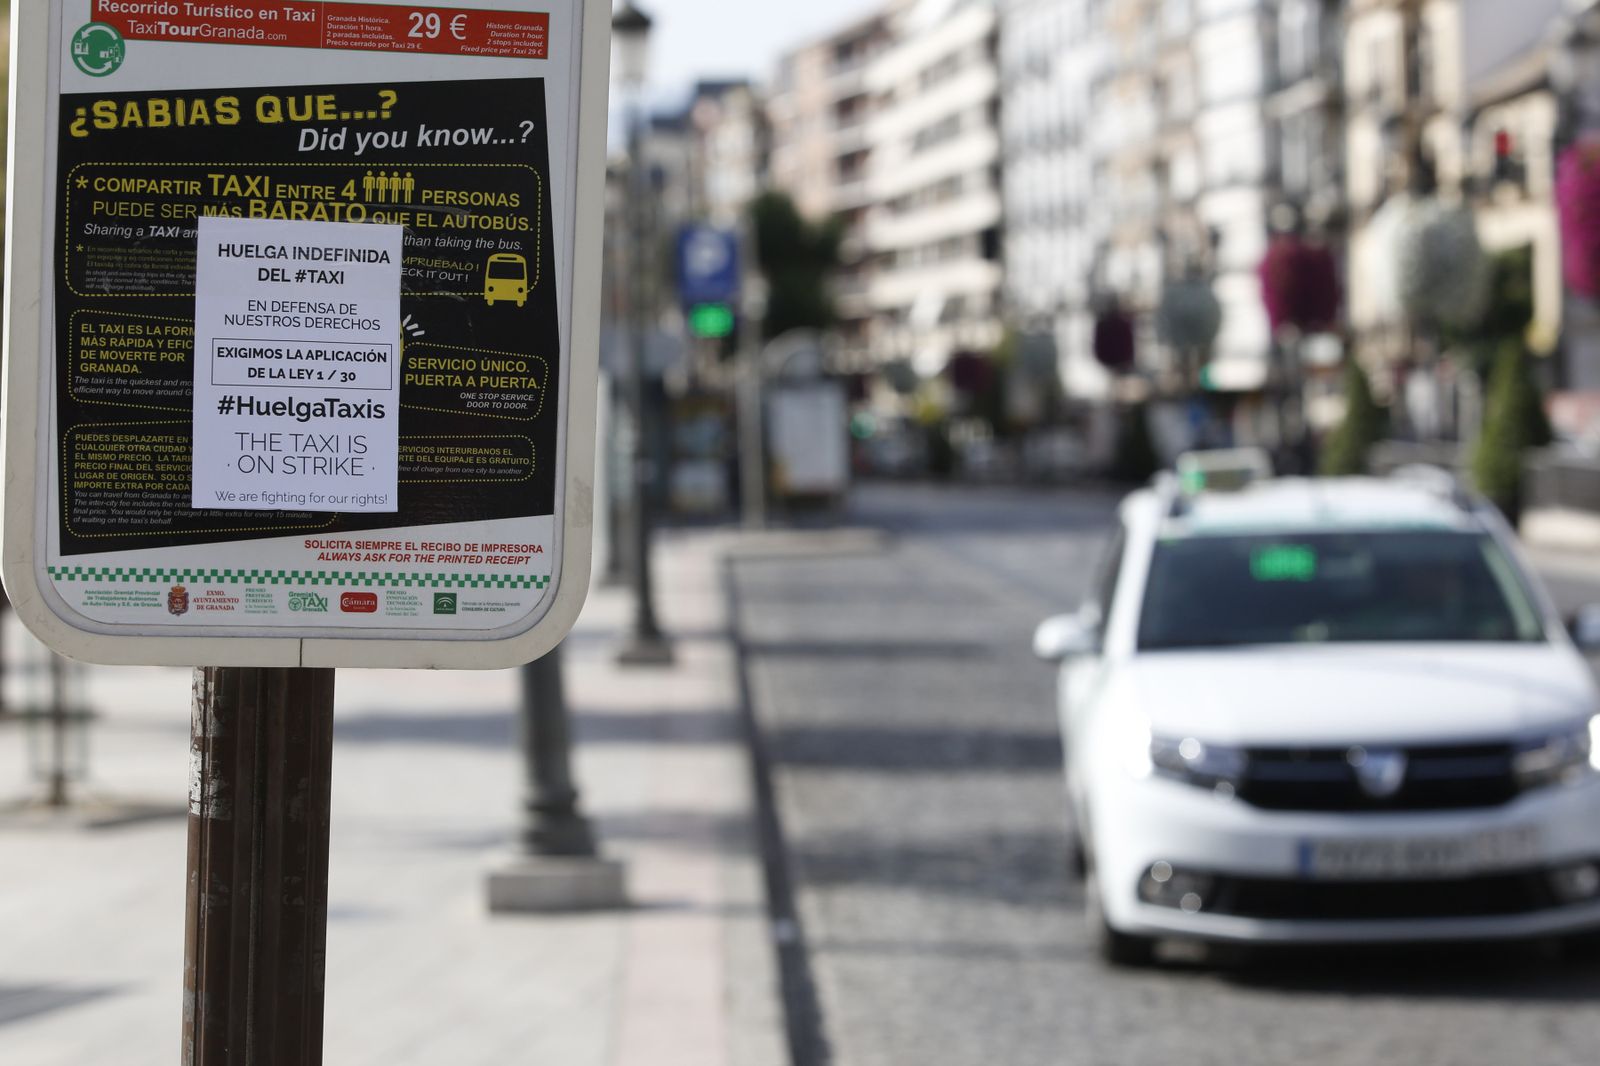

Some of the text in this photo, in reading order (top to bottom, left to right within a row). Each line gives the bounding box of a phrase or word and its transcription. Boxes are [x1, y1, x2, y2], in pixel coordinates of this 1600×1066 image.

[98, 0, 316, 21] Recorrido Turístico en Taxi
[327, 23, 358, 31] Duración
[358, 16, 391, 24] Histórica.
[407, 12, 468, 40] 29 €
[486, 22, 544, 31] Historic Granada.
[127, 20, 287, 42] TaxiTourGranada.com
[332, 32, 360, 40] paradas
[362, 33, 394, 41] incluidas.
[490, 30, 519, 38] Duration
[492, 39, 511, 47] stops
[70, 89, 401, 138] ¿SABIAS QUE...?
[298, 120, 535, 155] Did you know...?
[94, 173, 520, 208] COMPARTIR TAXI ENTRE 4 PERSONAS
[93, 199, 534, 232] PUEDE SER MÁS BARATO QUE EL AUTOBÚS.
[84, 223, 180, 239] Sharing a TAXI
[404, 235, 523, 251] than taking the bus.
[218, 243, 391, 264] HUELGA INDEFINIDA
[257, 267, 345, 285] DEL #TAXI
[426, 269, 464, 282] IT OUT
[248, 299, 358, 316] EN DEFENSA DE
[81, 323, 162, 336] EL TAXI ES LA
[224, 314, 381, 331] NUESTROS DERECHOS
[80, 335, 164, 349] MÁS RÁPIDA Y
[80, 350, 185, 362] DE MOVERTE POR
[217, 347, 387, 363] EXIGIMOS LA APLICACIÓN
[80, 362, 142, 374] GRANADA.
[408, 356, 530, 373] SERVICIO ÚNICO.
[74, 375, 178, 388] The taxi is the quickest and
[247, 367, 266, 379] DE
[269, 367, 286, 379] LA
[289, 368, 314, 380] LEY
[317, 370, 323, 381] 1
[340, 372, 356, 383] 30
[404, 373, 541, 390] PUERTA A PUERTA.
[74, 385, 104, 394] efficient
[105, 387, 121, 397] way
[122, 387, 131, 395] to
[156, 388, 184, 396] around
[460, 391, 536, 401] ONE STOP SERVICE.
[217, 395, 386, 423] #HuelgaTaxis
[466, 401, 529, 410] DOOR TO DOOR.
[75, 433, 188, 444] PUEDES DESPLAZARTE EN
[234, 432, 368, 455] THE TAXI IS
[75, 443, 187, 453] CUALQUIER OTRA CIUDAD
[437, 446, 513, 456] INTERURBANOS EL
[75, 453, 84, 461] EL
[88, 453, 116, 461] MISMO
[157, 455, 169, 463] LA
[417, 455, 432, 463] DEL
[434, 455, 474, 464] EQUIPAJE
[476, 456, 487, 464] ES
[74, 462, 107, 470] PRECIO
[110, 463, 134, 471] FINAL
[237, 455, 365, 477] ON STRIKE
[215, 491, 389, 507] We are fighting for our rights!
[304, 539, 544, 554] SOLICITA SIEMPRE EL RECIBO DE IMPRESORA
[317, 552, 531, 566] ALWAYS ASK FOR THE PRINTED RECEIPT
[301, 593, 328, 612] TAXI
